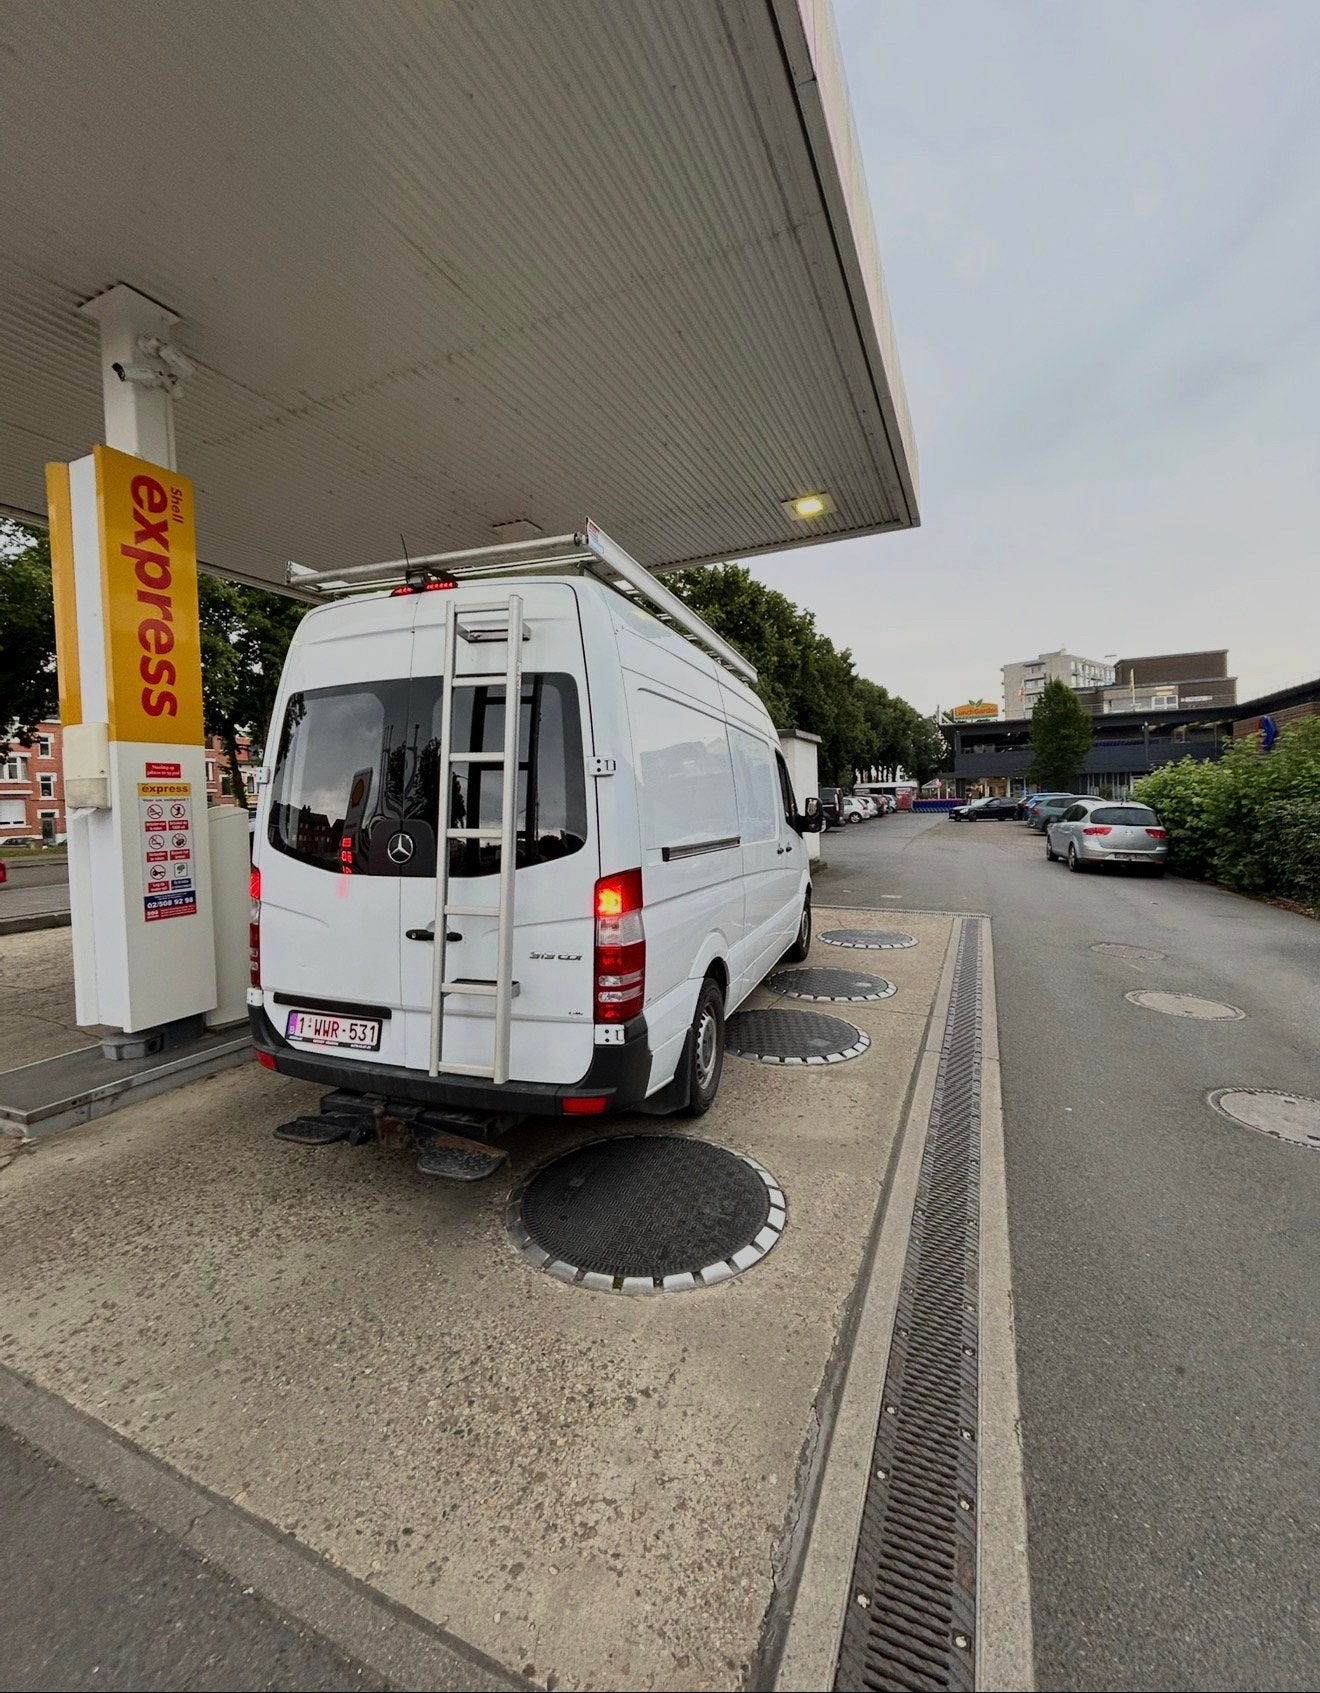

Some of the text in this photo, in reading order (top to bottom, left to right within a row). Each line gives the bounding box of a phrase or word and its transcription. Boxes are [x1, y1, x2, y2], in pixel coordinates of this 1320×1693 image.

[170, 487, 184, 524] Shell
[120, 474, 178, 718] express
[141, 785, 189, 794] express
[557, 951, 583, 961] CDI
[299, 1017, 376, 1043] 1-WWR-531
